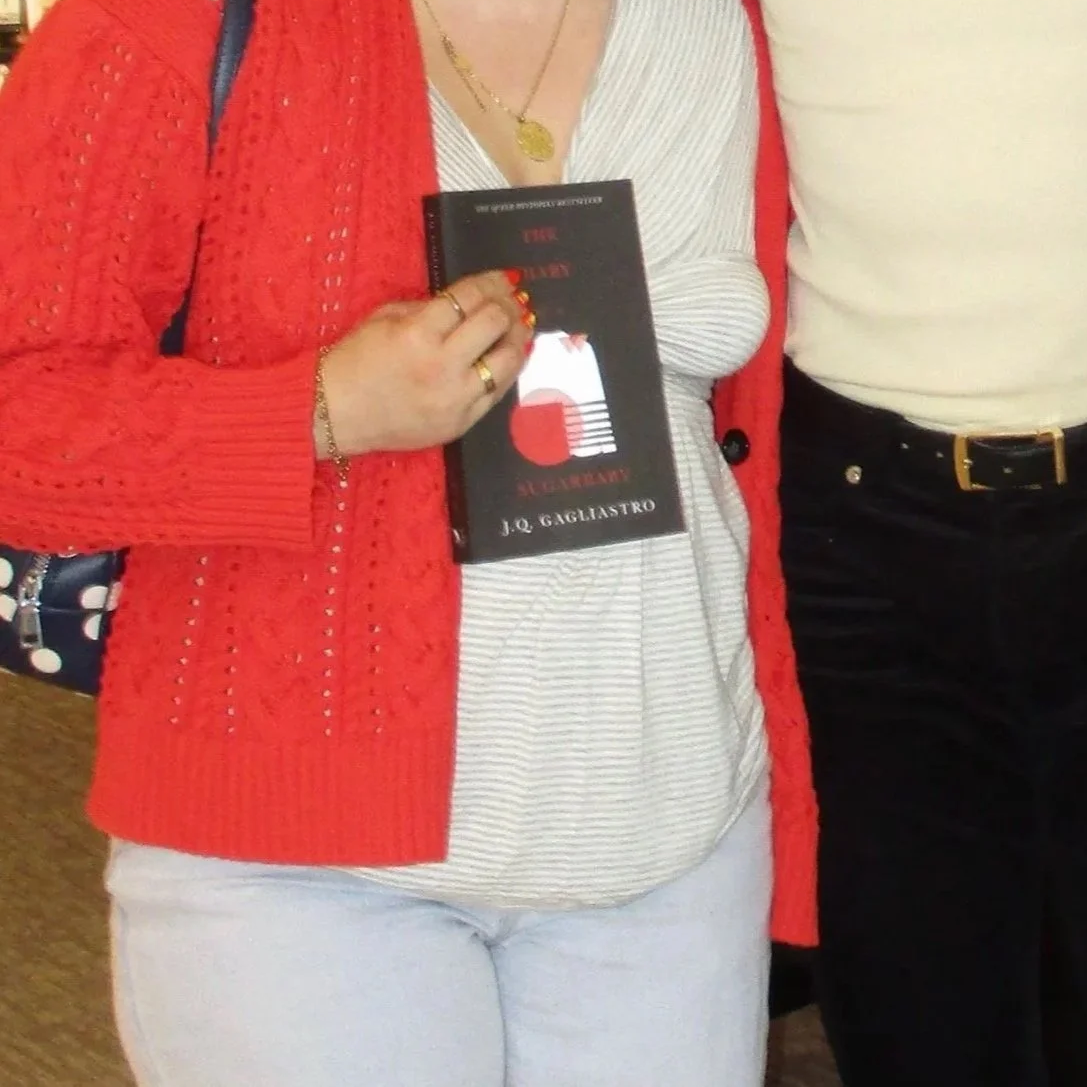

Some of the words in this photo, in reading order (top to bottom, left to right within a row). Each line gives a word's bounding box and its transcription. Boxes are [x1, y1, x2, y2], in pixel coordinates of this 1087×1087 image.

[516, 468, 631, 499] SUGARBABY
[501, 517, 534, 537] J.Q.
[538, 498, 657, 529] GAGLIASTRO
